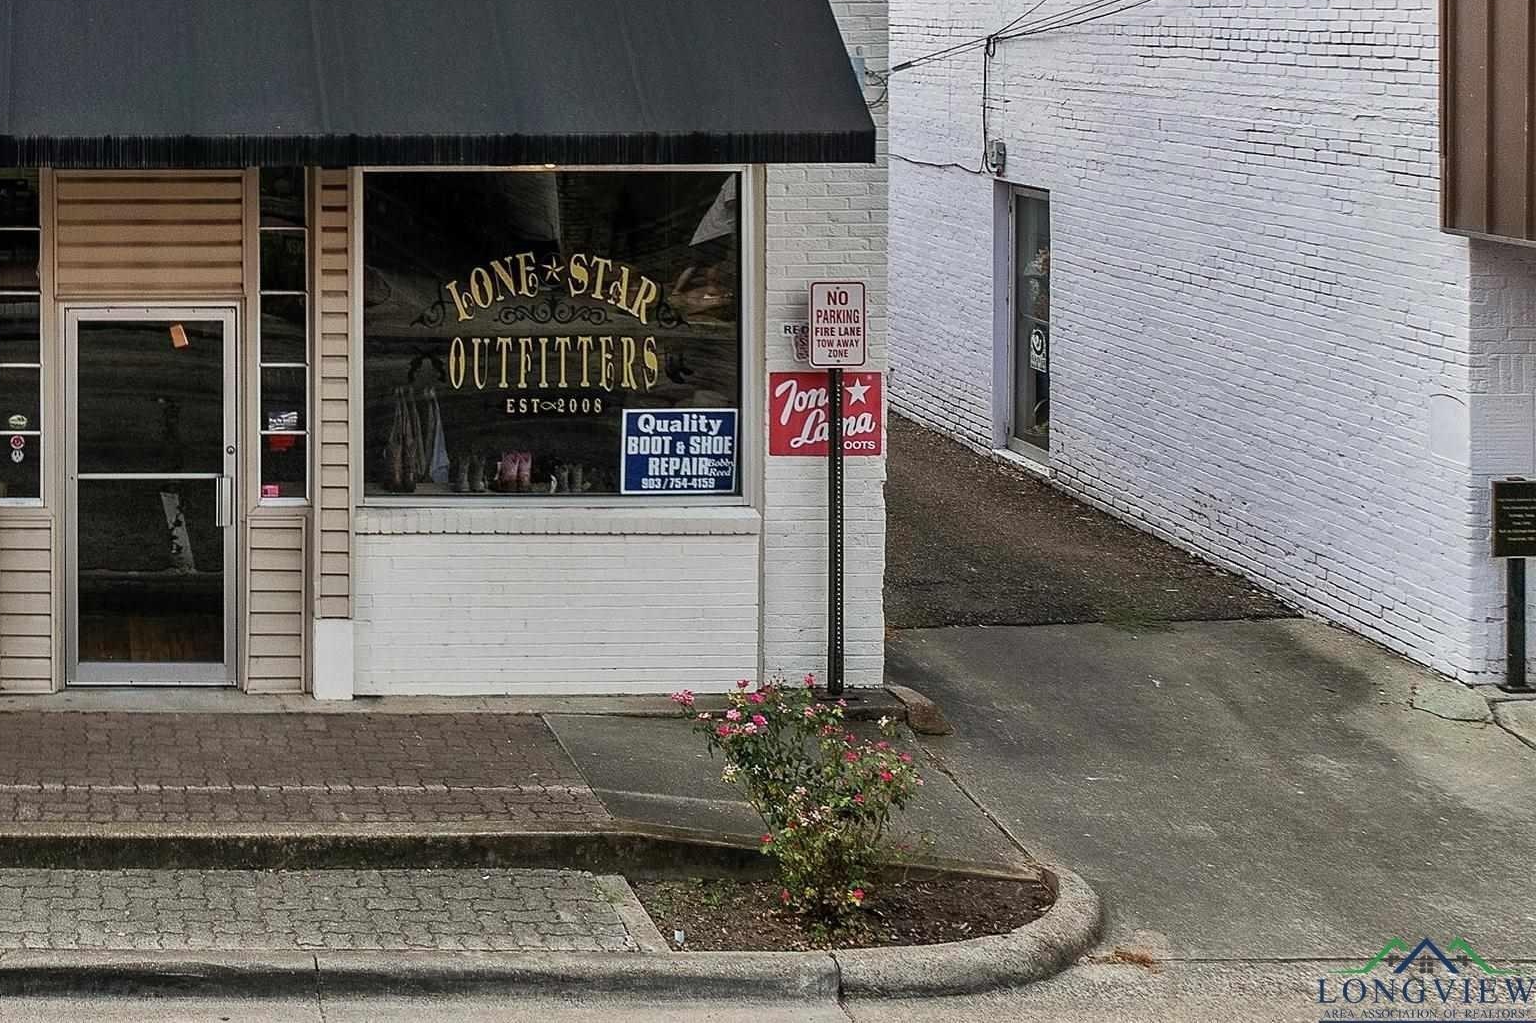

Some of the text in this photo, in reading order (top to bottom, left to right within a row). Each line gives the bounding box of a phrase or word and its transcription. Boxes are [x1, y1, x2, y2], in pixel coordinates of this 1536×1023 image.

[445, 251, 658, 324] LONE STAR
[827, 291, 849, 306] NO
[816, 309, 860, 324] PARKING
[815, 327, 862, 336] FIRE LANE
[816, 338, 860, 347] TOW AWAY
[827, 348, 849, 358] ZONE
[447, 335, 659, 393] OUTFITTERS
[506, 398, 603, 414] EST 2008
[774, 379, 831, 426] Ton
[637, 413, 723, 436] Quality
[627, 436, 733, 455] BOOT & SHOE
[843, 440, 876, 450] OOTS
[648, 457, 709, 476] REPAIR
